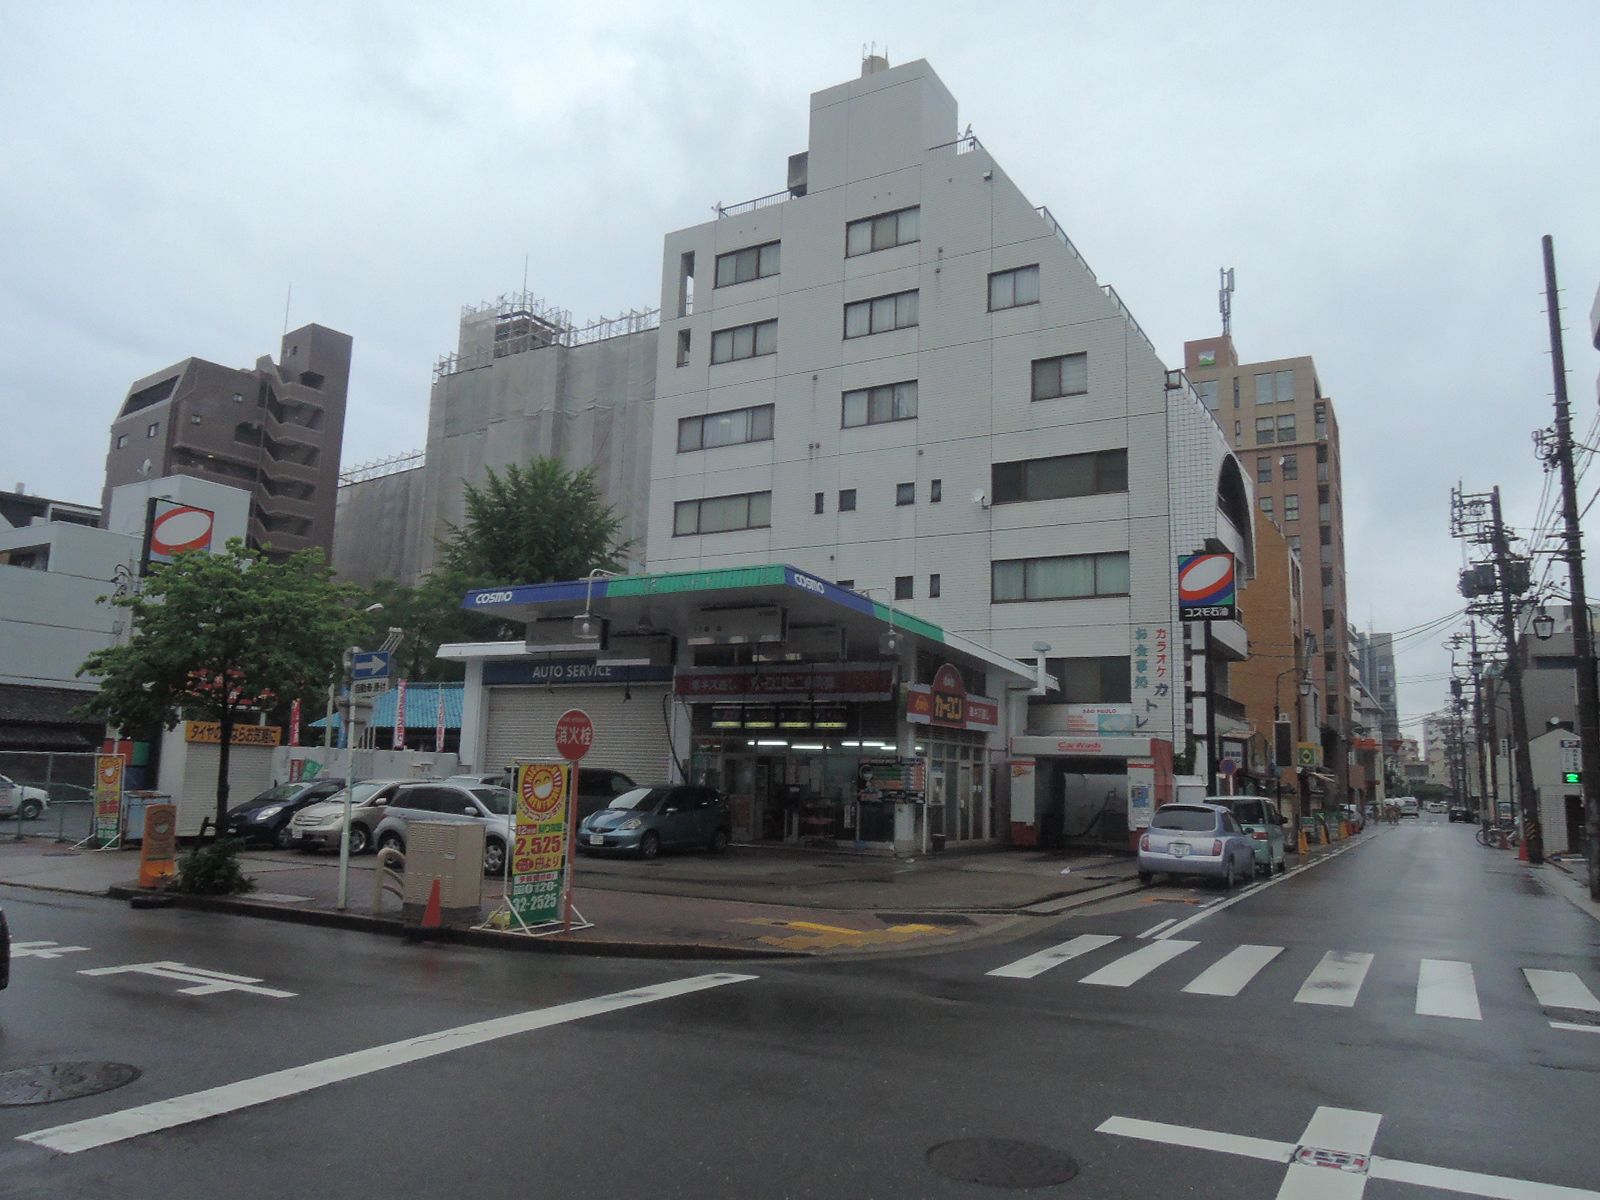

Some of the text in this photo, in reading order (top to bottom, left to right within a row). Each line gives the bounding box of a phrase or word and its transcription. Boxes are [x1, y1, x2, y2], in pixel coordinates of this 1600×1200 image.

[794, 573, 825, 594] COSMO
[475, 591, 513, 604] COSMO
[1184, 606, 1229, 618] コスモ石油
[1155, 628, 1168, 678] カラオケ
[531, 663, 612, 678] AUTO SERVICE
[556, 725, 592, 745] 消火栓
[514, 835, 561, 856] 2,525
[534, 855, 560, 870] 円より
[512, 892, 557, 912] 32-2525
